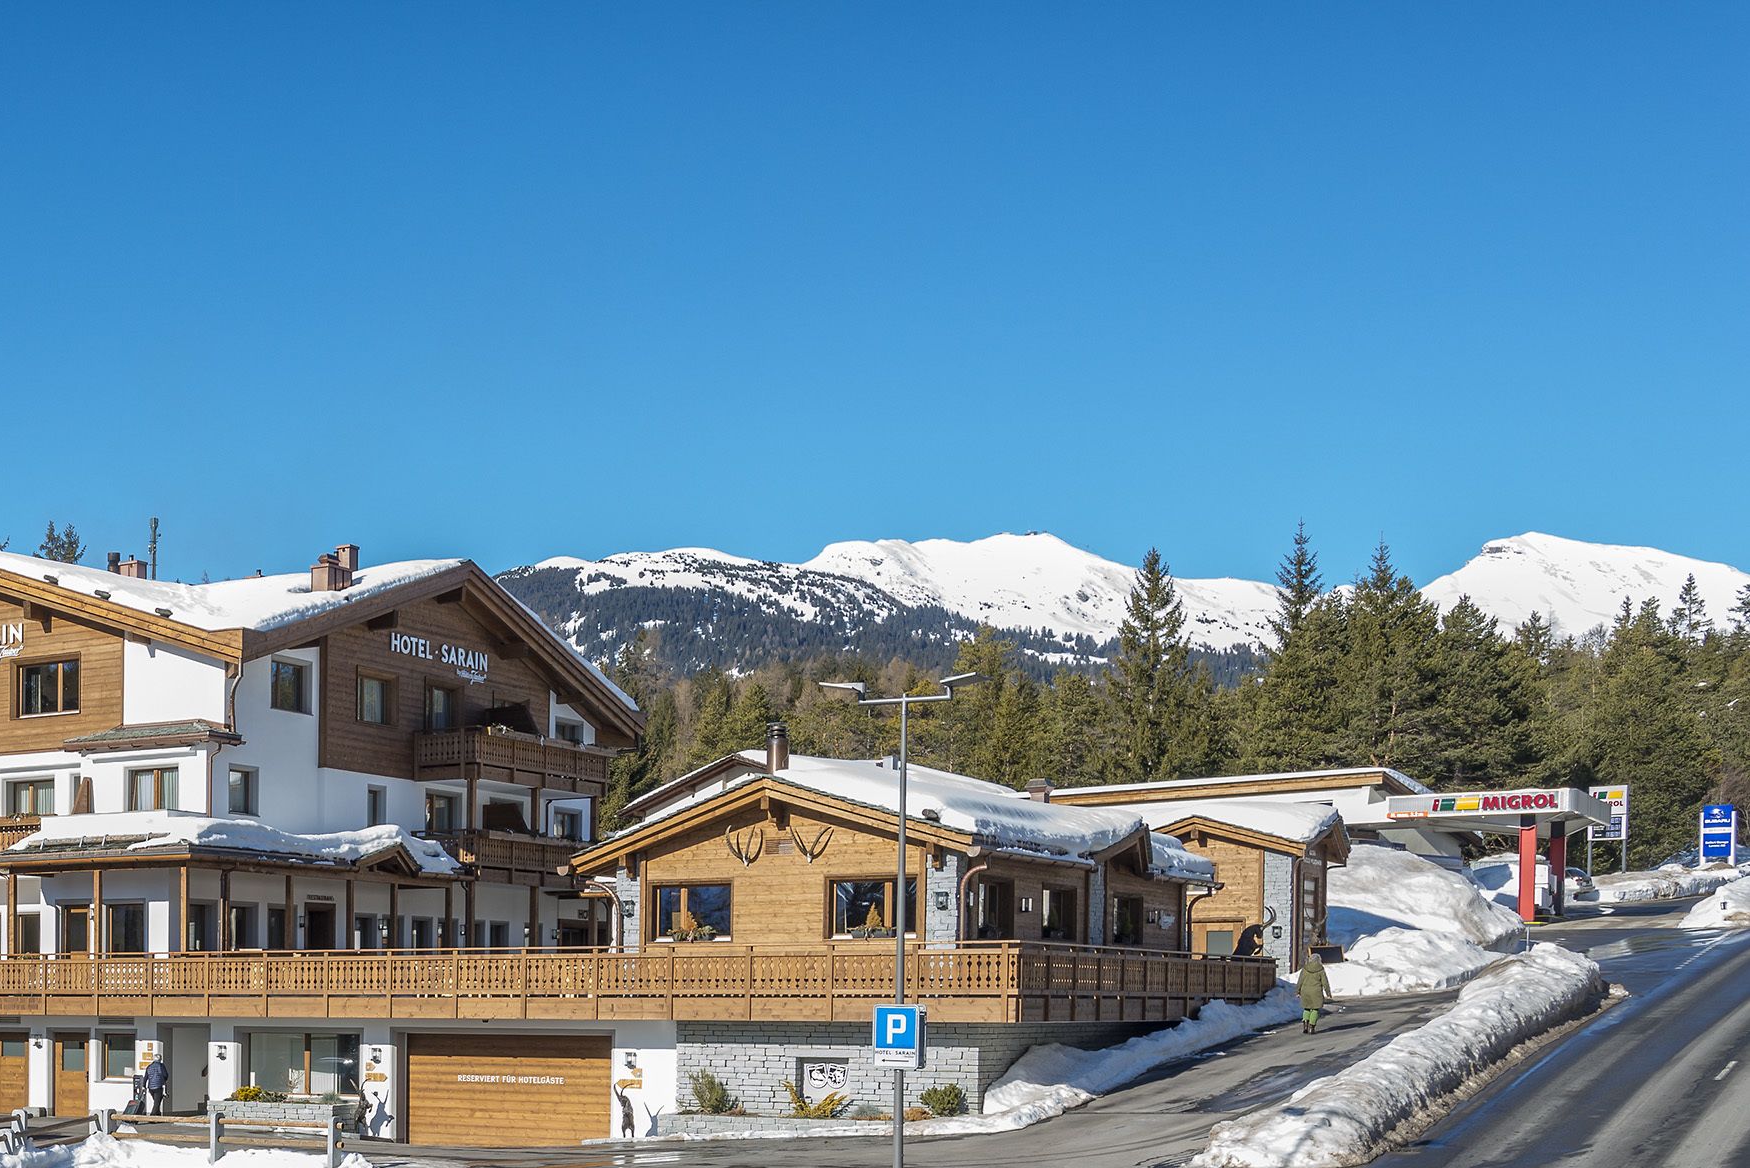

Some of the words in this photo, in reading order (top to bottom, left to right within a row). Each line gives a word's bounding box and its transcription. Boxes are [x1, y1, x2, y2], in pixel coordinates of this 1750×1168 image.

[391, 632, 433, 660] HOTEL
[441, 644, 488, 672] SARAIN
[1482, 793, 1559, 811] MIGROL
[887, 1014, 906, 1044] P
[457, 1074, 500, 1083] RESERVIERT
[502, 1075, 516, 1083] FÜR
[518, 1076, 565, 1085] HOTELGÄSTE
